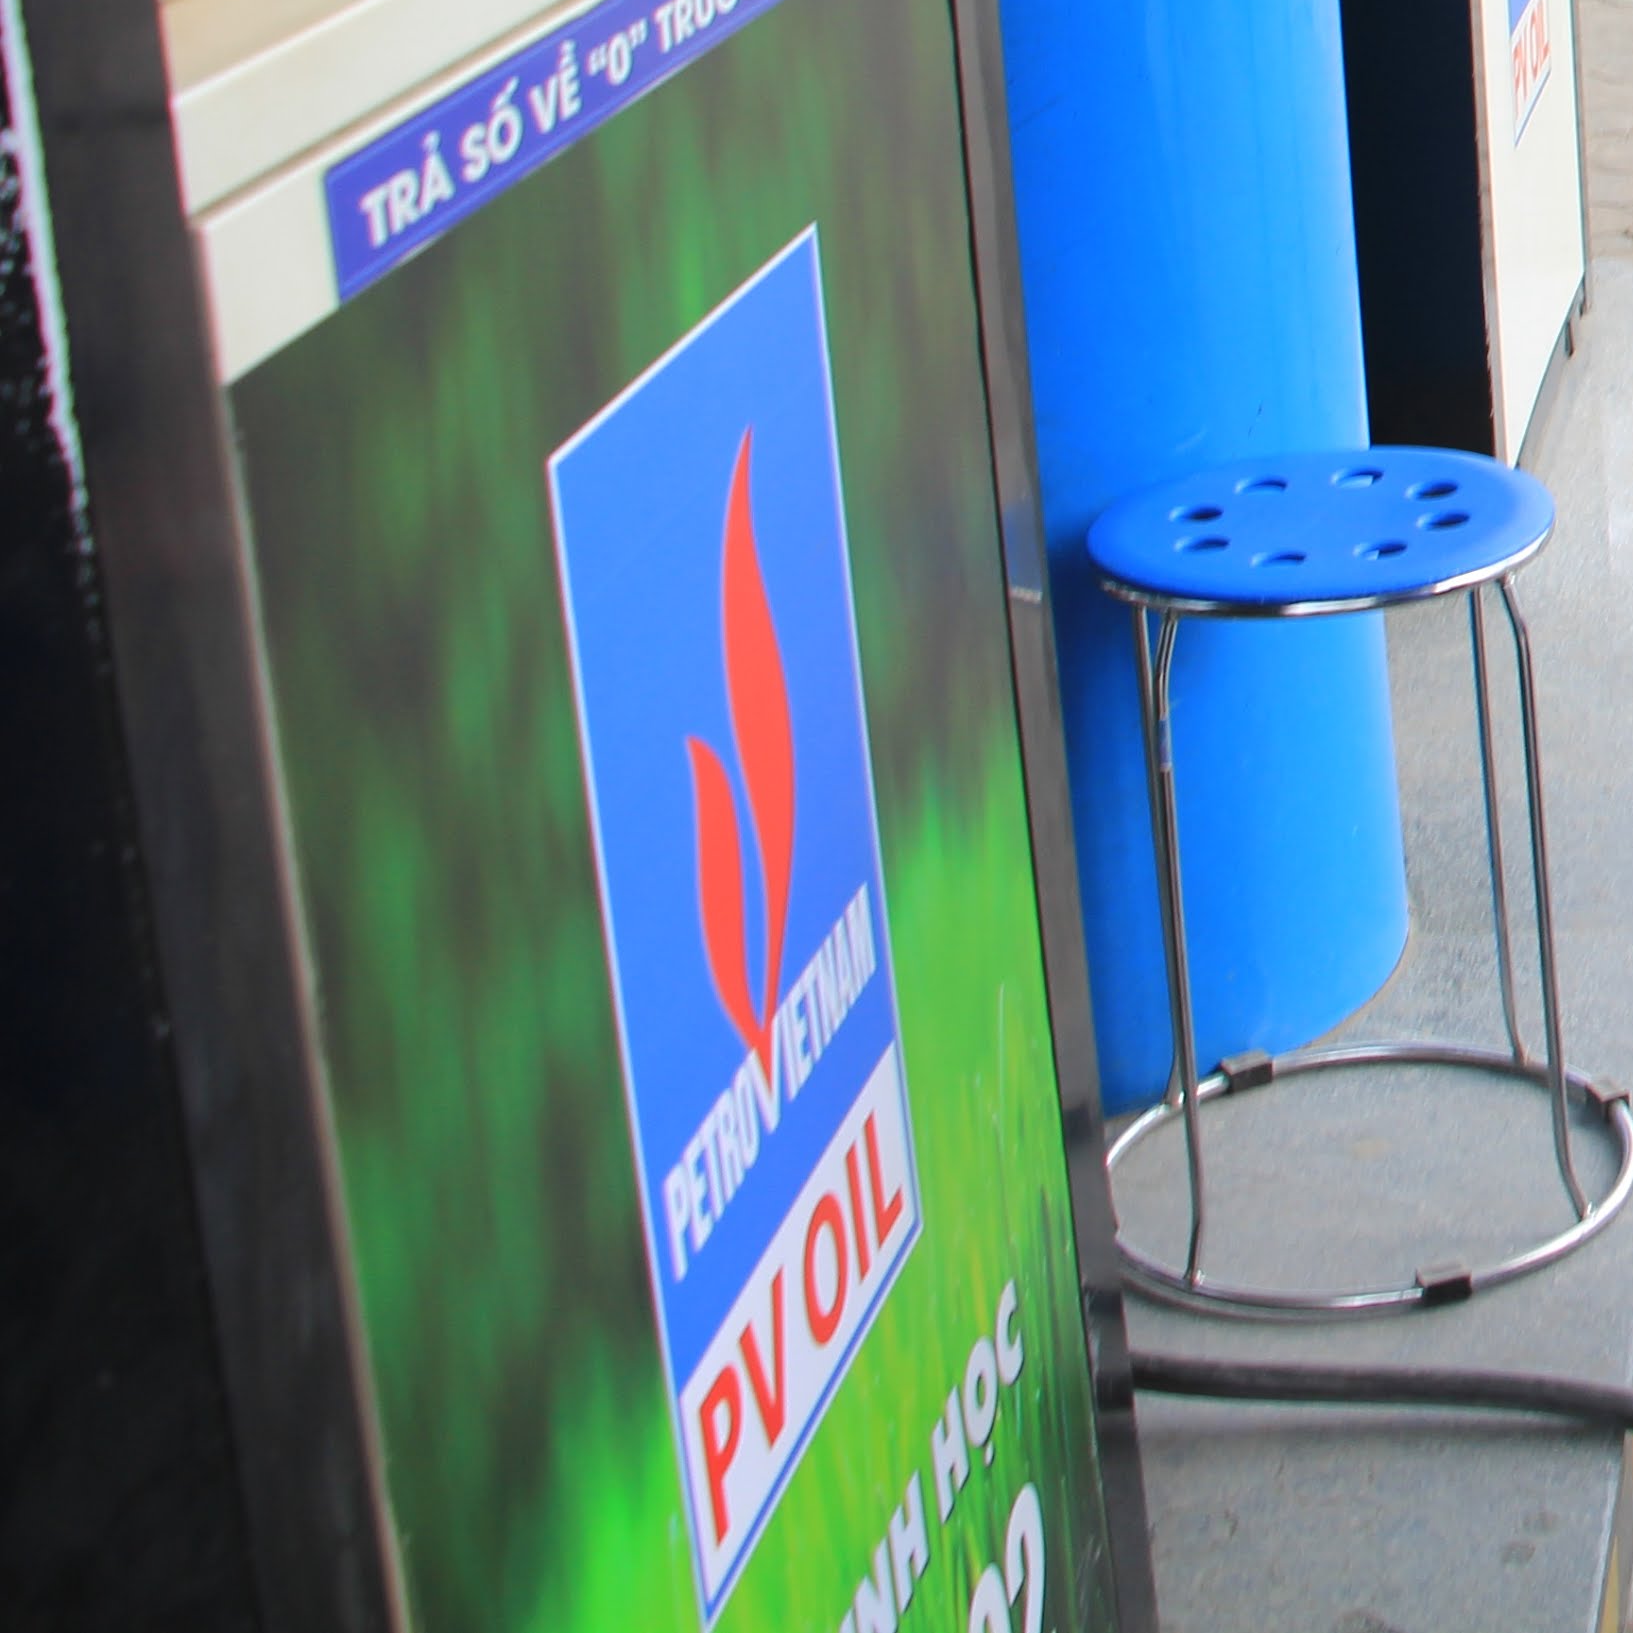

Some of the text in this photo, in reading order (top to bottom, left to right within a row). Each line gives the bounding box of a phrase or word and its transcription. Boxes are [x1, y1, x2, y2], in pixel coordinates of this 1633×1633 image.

[362, 131, 454, 248] TRẢ
[460, 78, 521, 183] SỐ
[530, 41, 582, 135] VỀ
[663, 881, 876, 1282] PETROVIETNAM
[699, 1109, 904, 1548] PV OIL
[838, 1468, 929, 1633] NH
[932, 1279, 1024, 1526] HỌC
